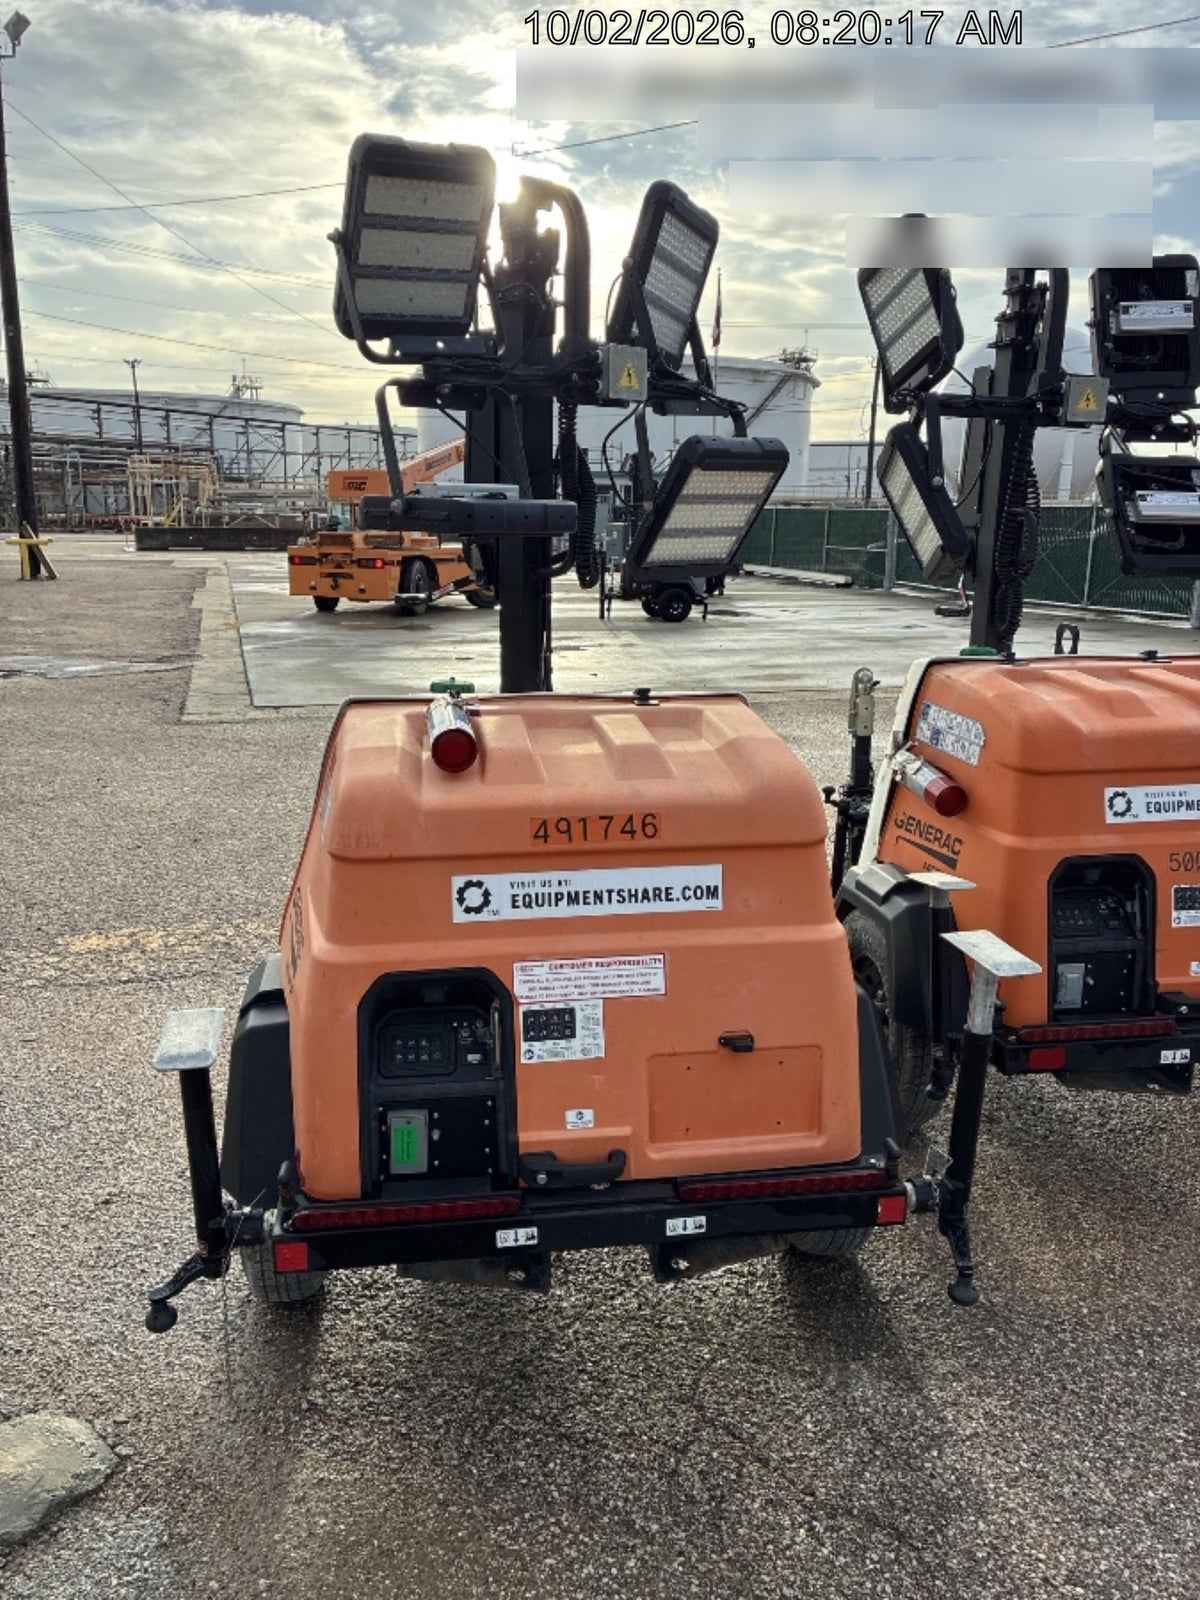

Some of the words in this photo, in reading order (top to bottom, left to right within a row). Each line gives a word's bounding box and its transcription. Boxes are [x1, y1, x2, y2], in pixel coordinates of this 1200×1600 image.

[532, 813, 659, 844] 491746
[893, 811, 964, 856] GENERAC
[509, 880, 536, 890] VISIT
[540, 879, 553, 888] US
[510, 884, 719, 910] EQUIPMENTSHARE.COM
